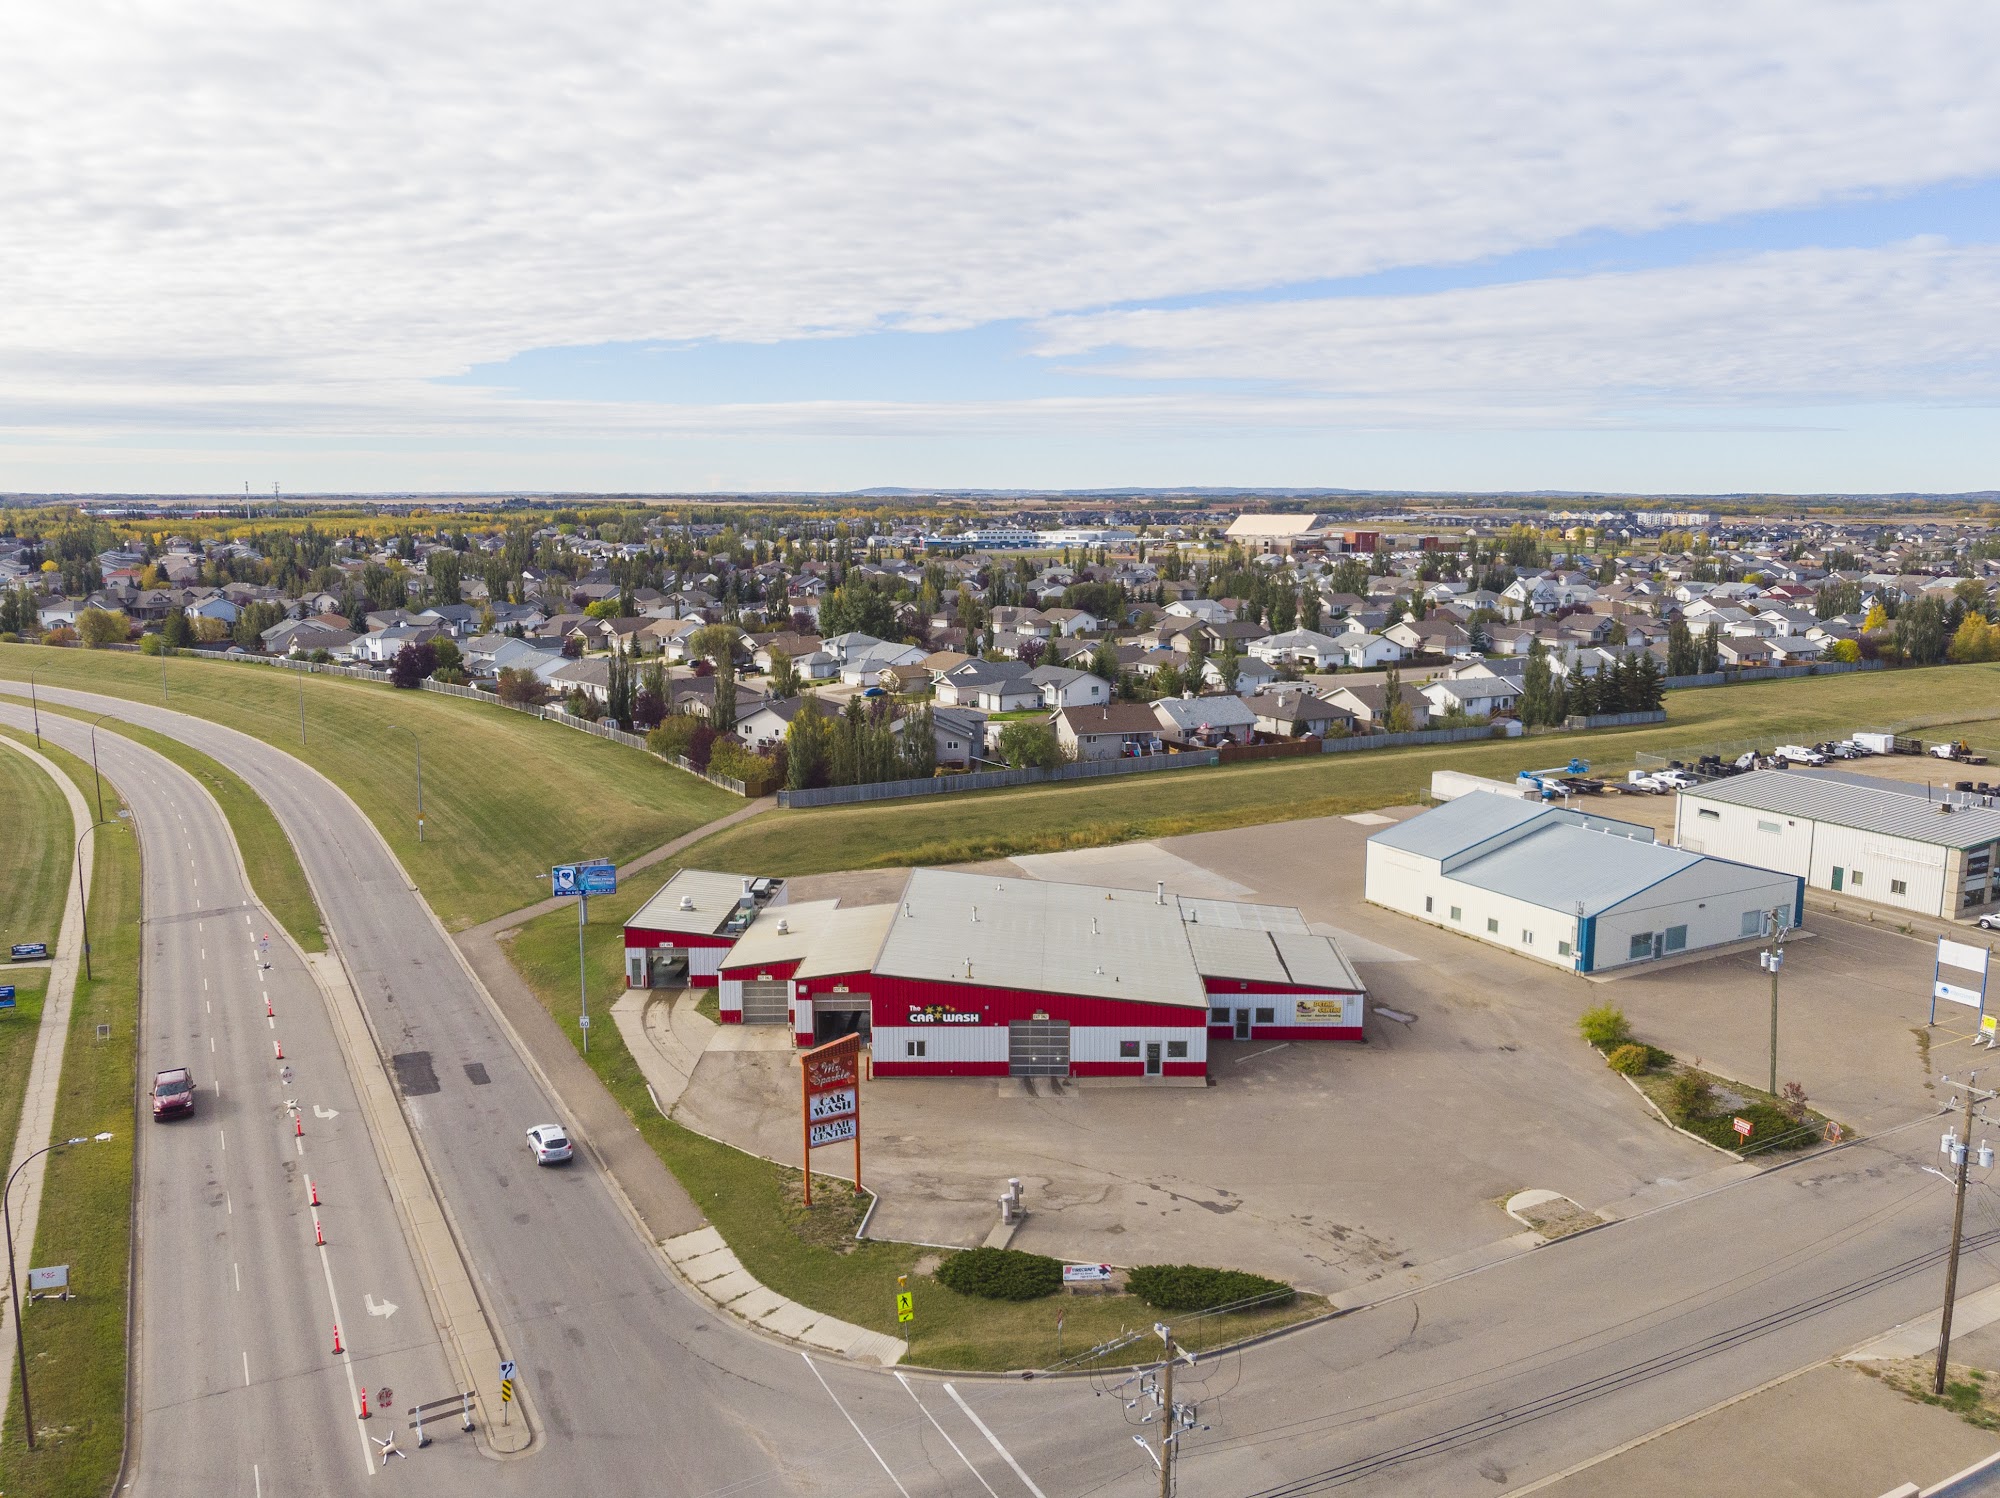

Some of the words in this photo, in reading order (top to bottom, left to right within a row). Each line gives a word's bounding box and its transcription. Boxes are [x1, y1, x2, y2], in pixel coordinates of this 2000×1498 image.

[909, 1013, 934, 1022] CAR
[942, 1013, 979, 1022] WASH
[821, 1062, 841, 1074] Mr.
[813, 1069, 850, 1087] Sparkle
[820, 1093, 845, 1107] CAR
[814, 1100, 851, 1117] WASH
[812, 1126, 853, 1141] CENTRE
[814, 1120, 853, 1134] DETAIL
[41, 1271, 55, 1279] KSG
